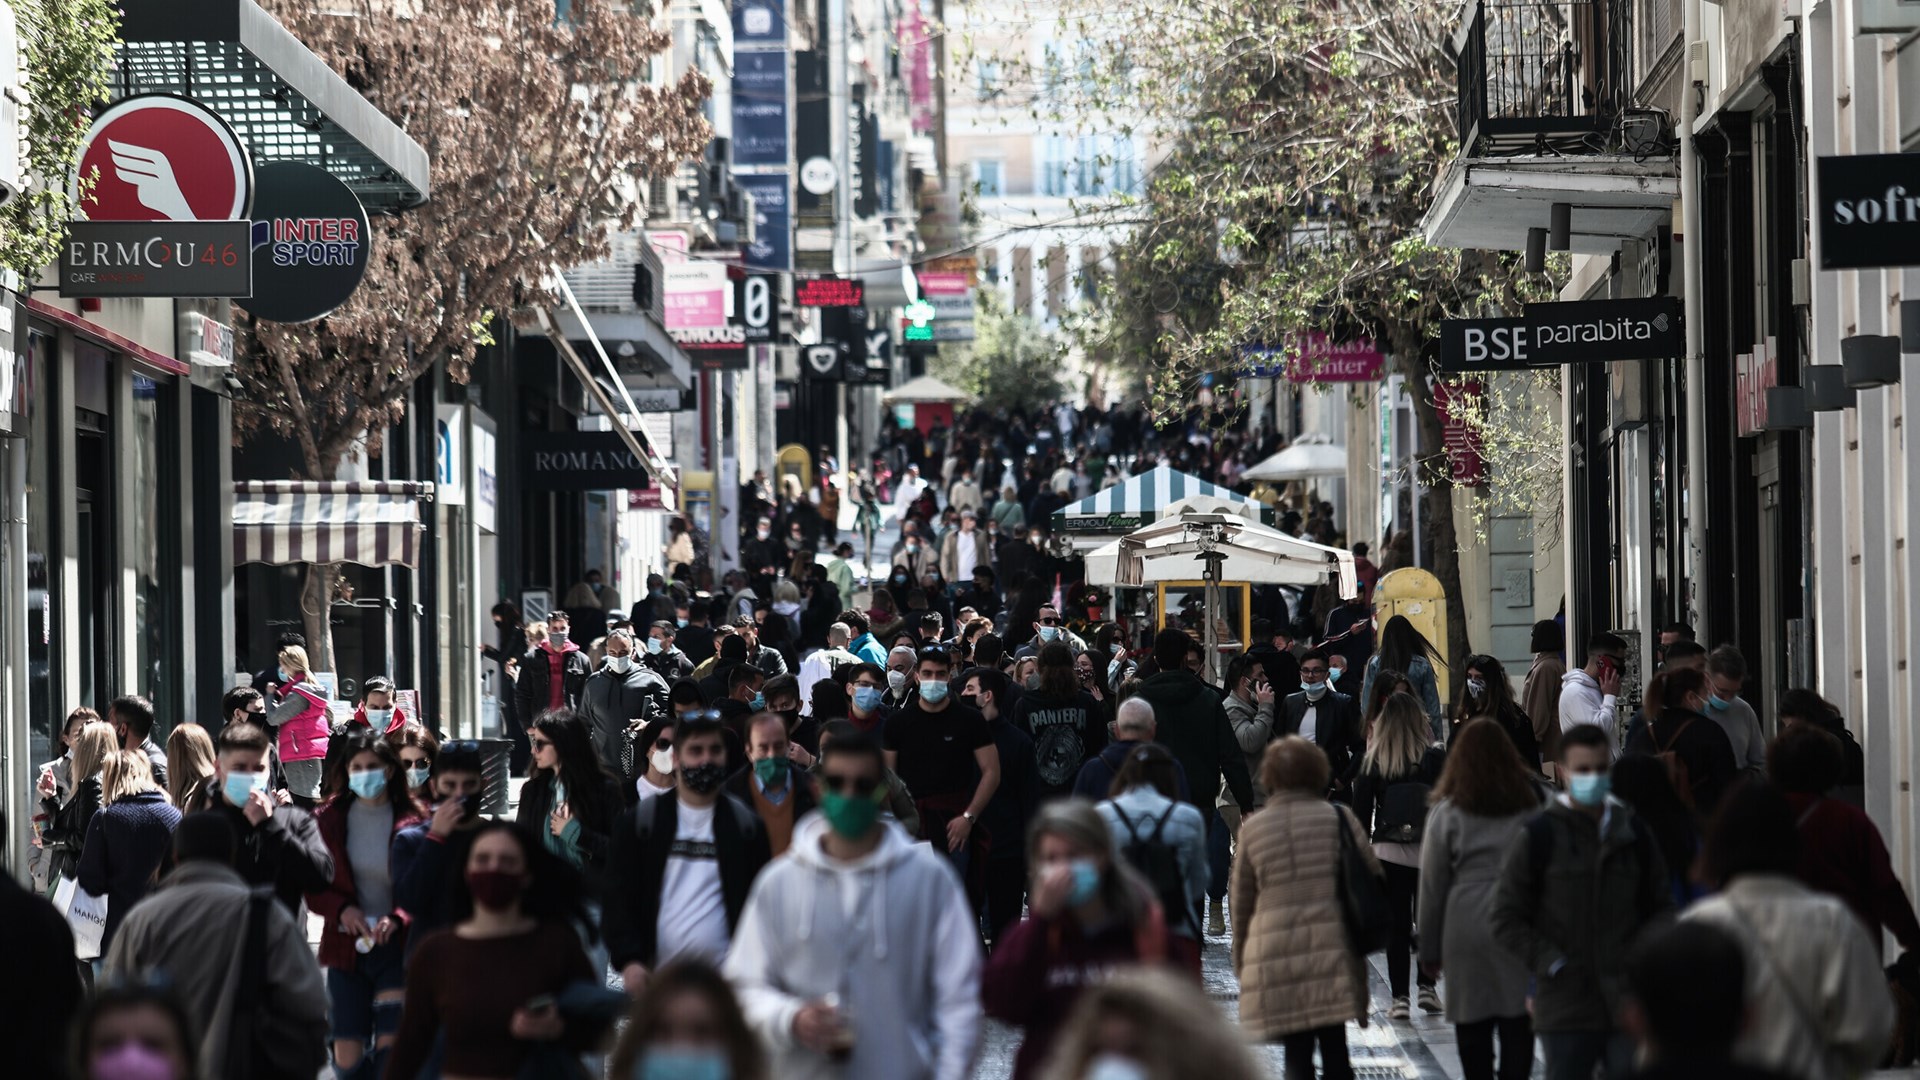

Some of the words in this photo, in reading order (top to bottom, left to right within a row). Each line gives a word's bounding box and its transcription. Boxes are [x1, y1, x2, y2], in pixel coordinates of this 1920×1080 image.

[274, 218, 359, 242] INTER
[272, 241, 360, 266] SPORT
[70, 272, 96, 283] CAFE
[1536, 317, 1651, 348] parabita
[1066, 519, 1105, 528] ERMOU
[1105, 514, 1140, 527] Flower
[1029, 707, 1087, 734] PANTERA
[74, 906, 106, 928] MANGO
